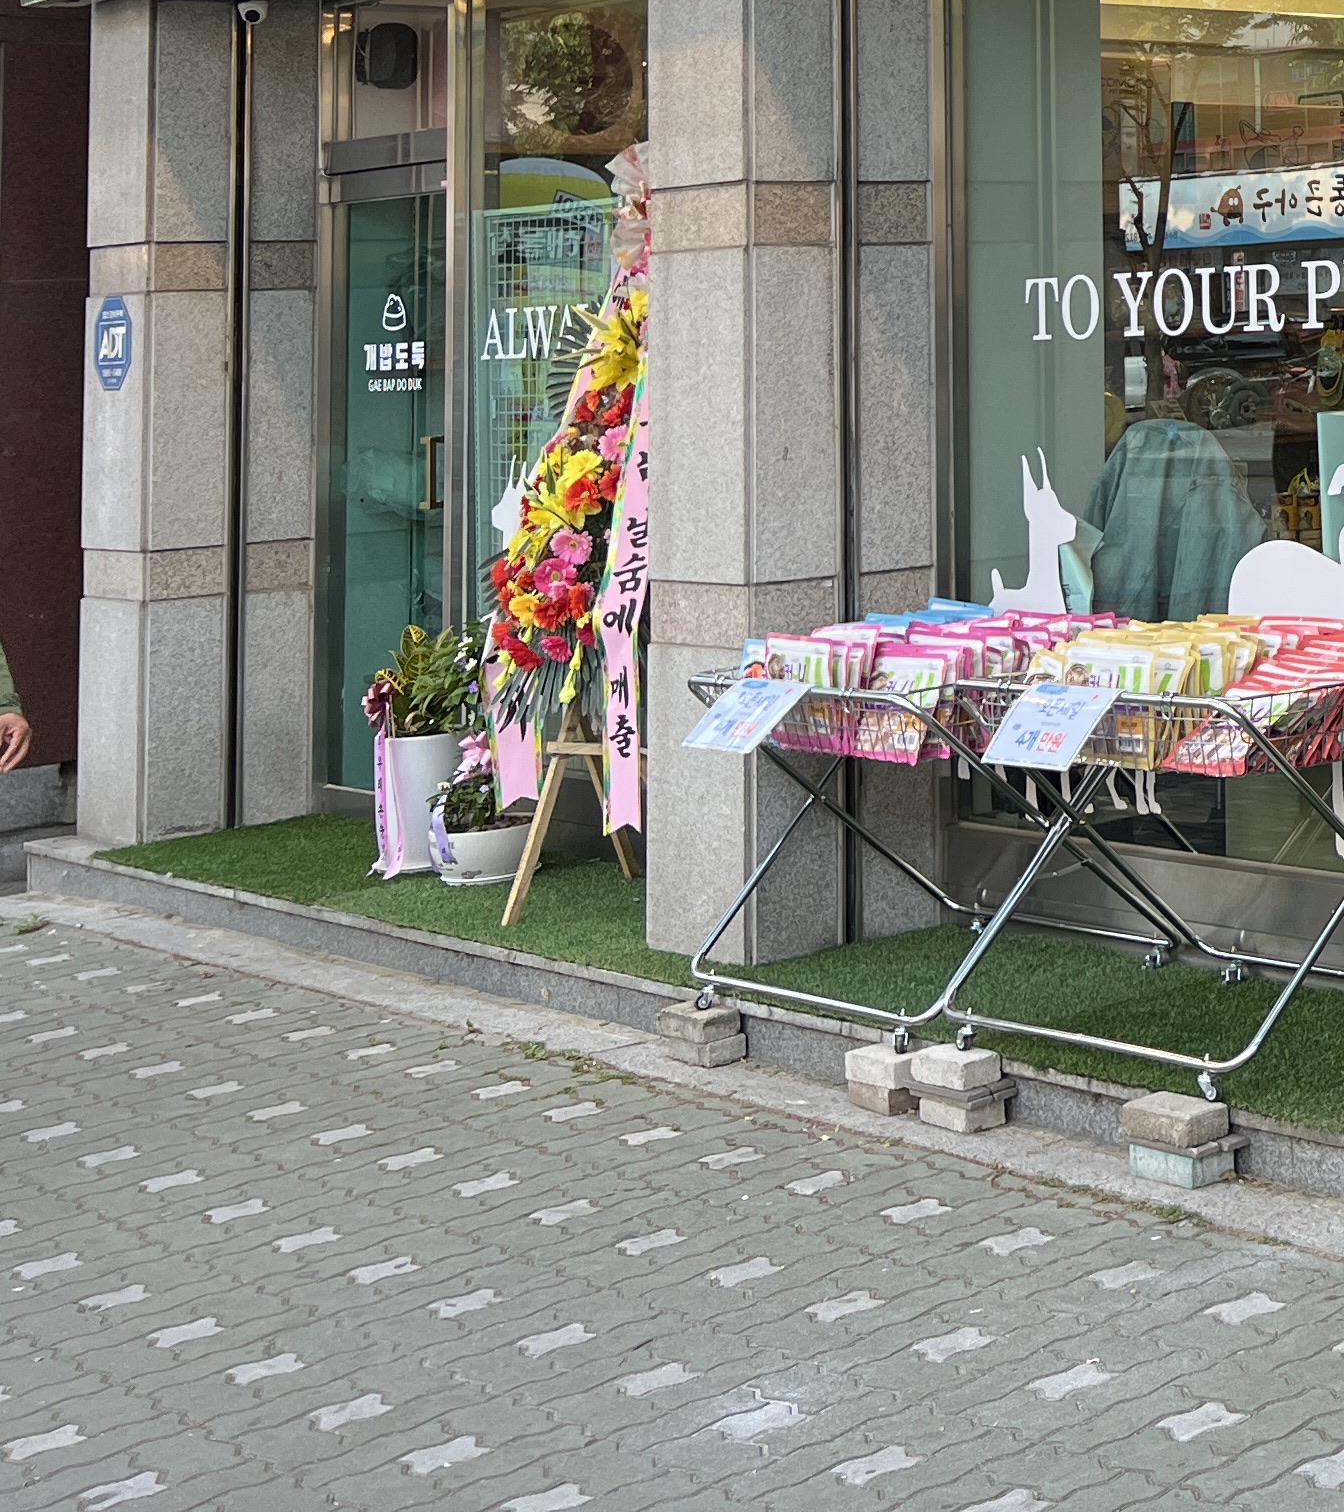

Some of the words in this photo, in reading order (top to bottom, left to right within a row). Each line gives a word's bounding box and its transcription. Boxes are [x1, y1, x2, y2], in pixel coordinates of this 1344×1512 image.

[1025, 273, 1100, 342] TO
[1112, 262, 1286, 338] YOUR
[98, 326, 127, 360] ADT
[363, 340, 425, 372] 개밥도둑
[480, 303, 589, 361] ALWA
[608, 665, 637, 759] 매출
